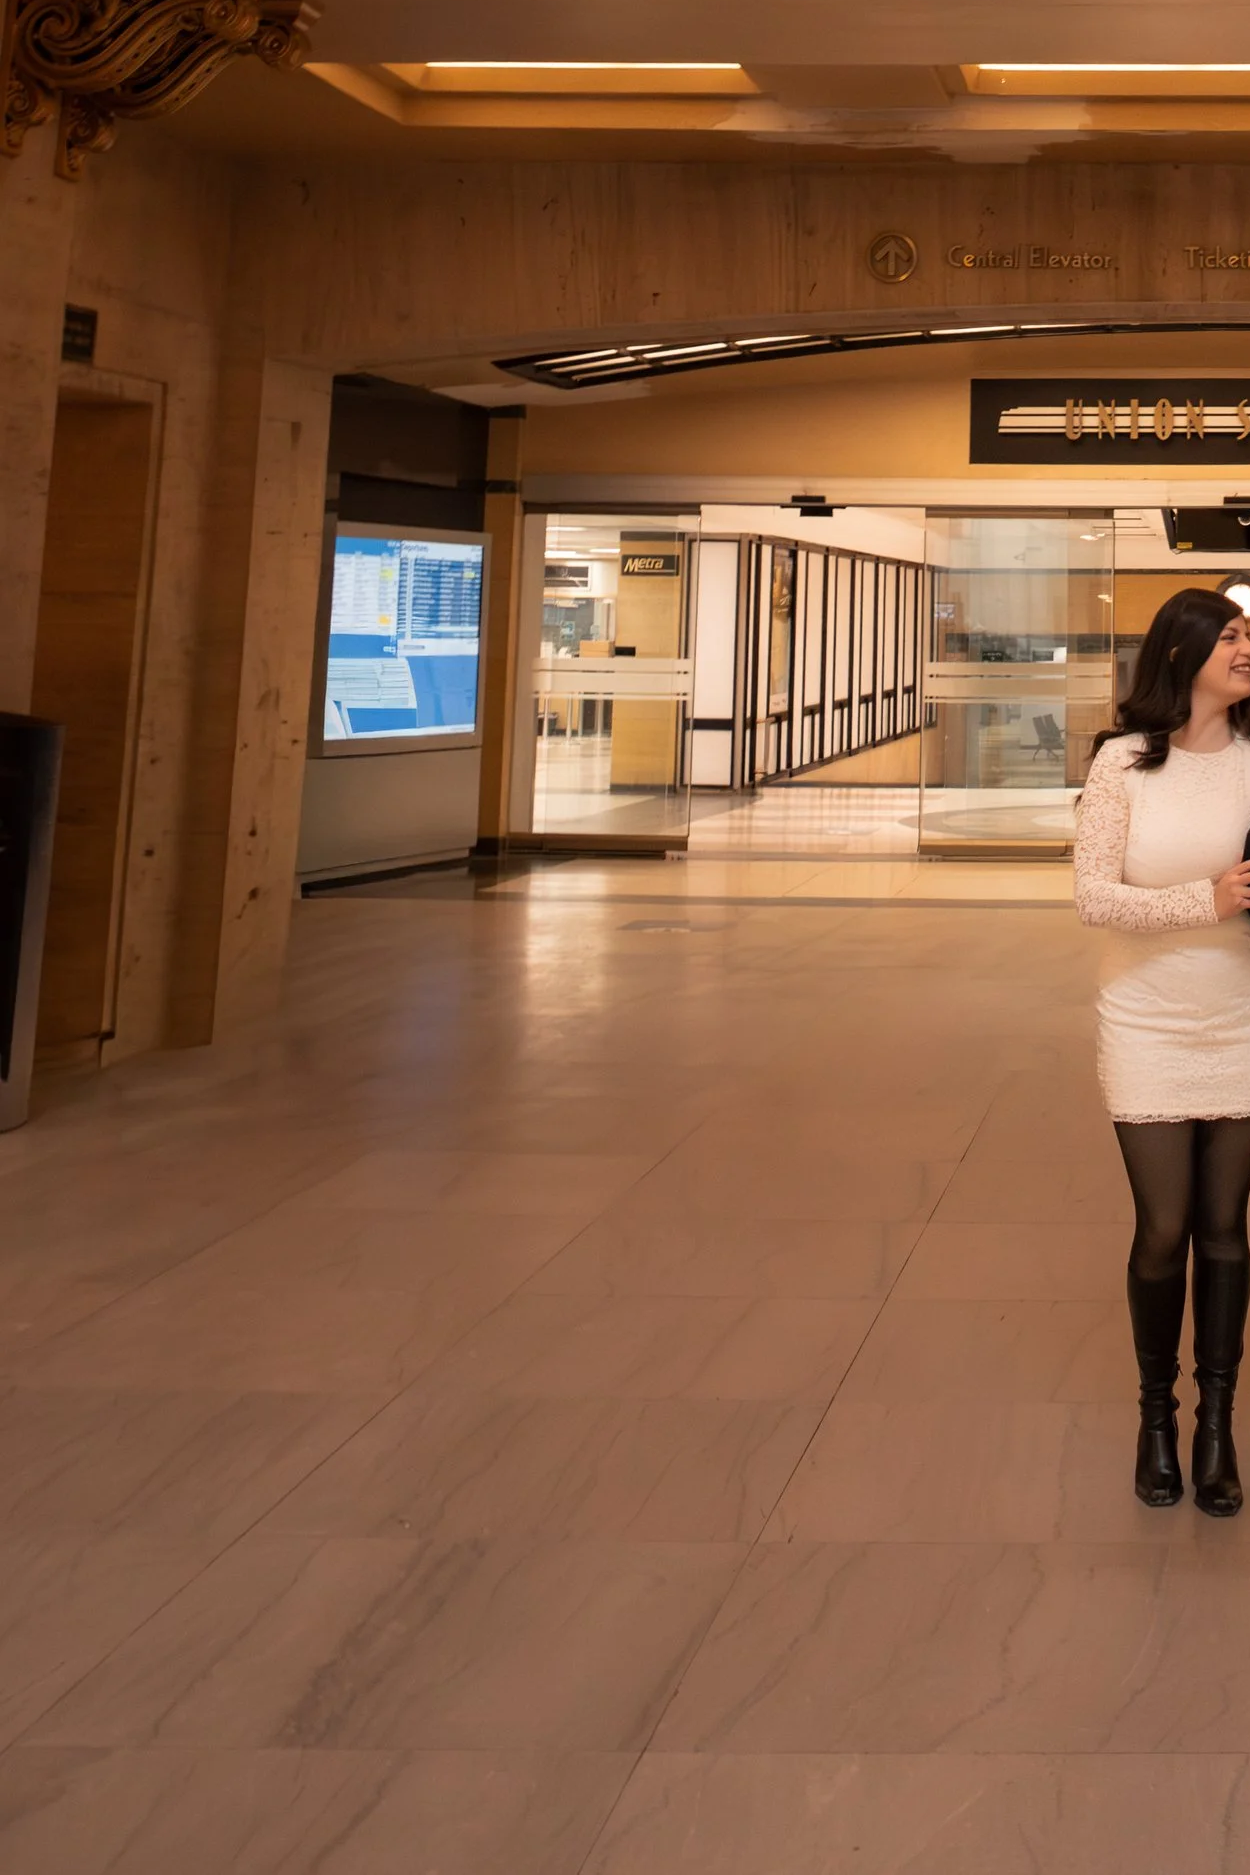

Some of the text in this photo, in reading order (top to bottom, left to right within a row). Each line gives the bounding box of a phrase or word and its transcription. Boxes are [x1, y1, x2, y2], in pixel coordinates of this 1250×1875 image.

[949, 245, 1111, 268] Central Elevator
[1065, 398, 1204, 440] UNION
[624, 557, 664, 572] Metra
